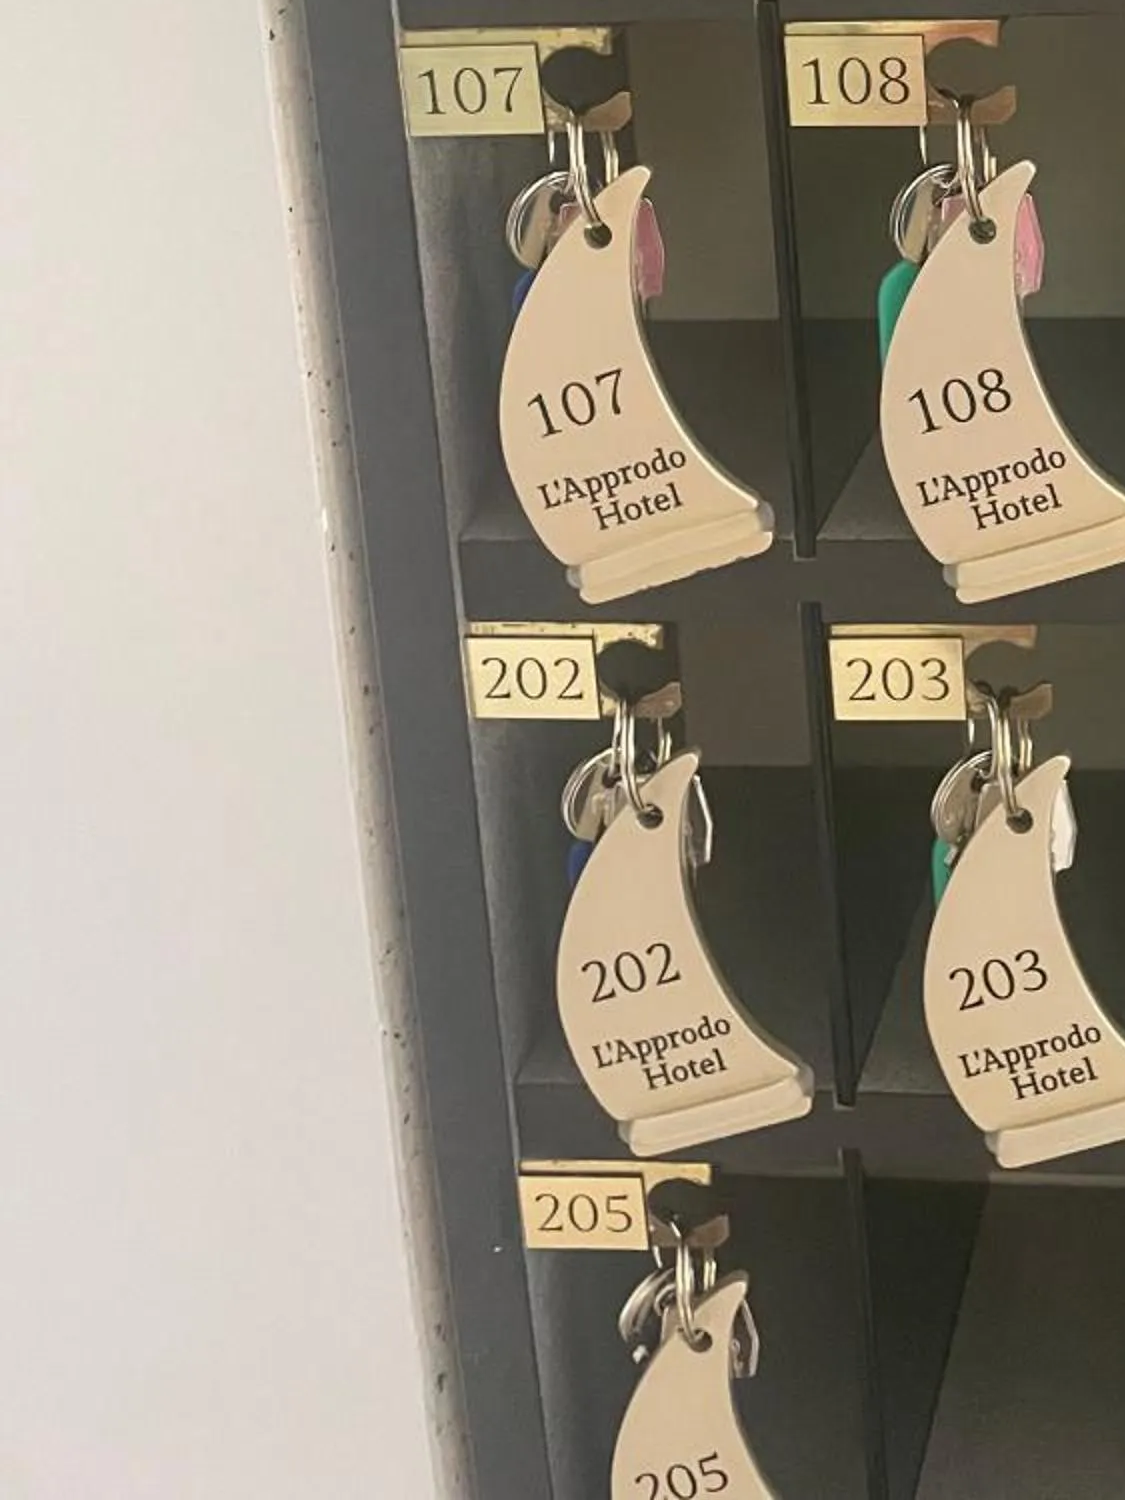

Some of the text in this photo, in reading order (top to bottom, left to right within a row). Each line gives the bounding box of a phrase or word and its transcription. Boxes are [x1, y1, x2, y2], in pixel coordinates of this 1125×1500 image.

[418, 66, 523, 115] 107
[802, 56, 910, 105] 108
[527, 368, 622, 437] 107
[908, 368, 1012, 435] 108
[536, 447, 687, 510] L'Approdo
[915, 447, 1067, 507] L'Approdo
[591, 481, 683, 531] Hotel
[970, 483, 1063, 531] Hotel
[481, 657, 584, 701] 202
[846, 657, 950, 702] 203
[581, 942, 681, 1003] 202
[948, 949, 1048, 1012] 203
[591, 1015, 731, 1069] L'Approdo
[957, 1023, 1102, 1079] L'Approdo
[642, 1047, 728, 1091] Hotel
[1010, 1056, 1099, 1101] Hotel
[534, 1193, 633, 1234] 205
[634, 1451, 729, 1500] 205
